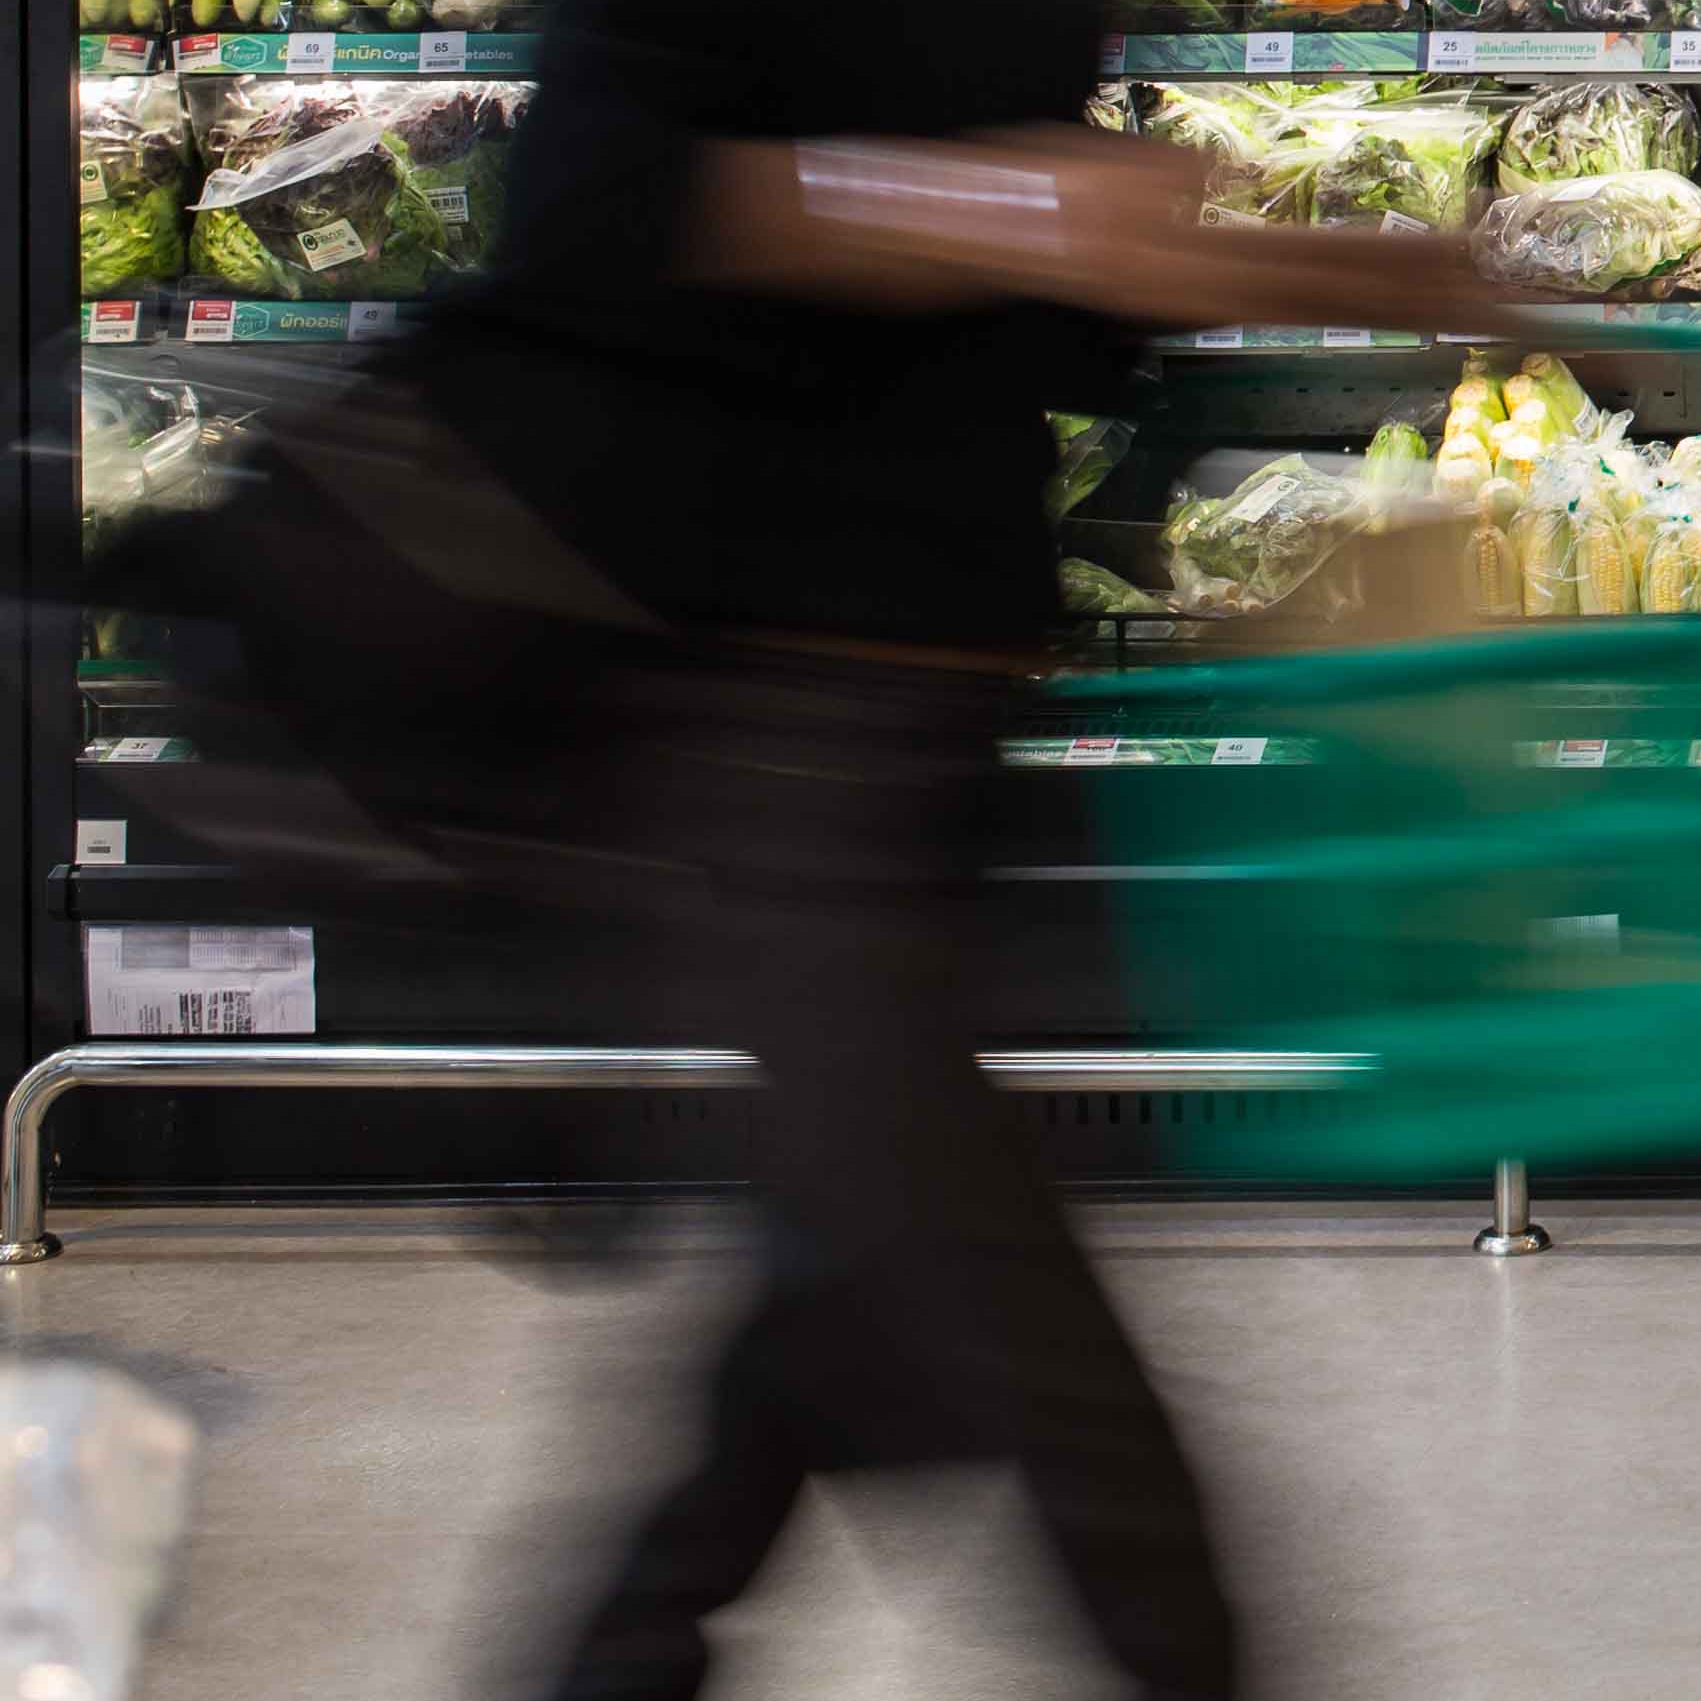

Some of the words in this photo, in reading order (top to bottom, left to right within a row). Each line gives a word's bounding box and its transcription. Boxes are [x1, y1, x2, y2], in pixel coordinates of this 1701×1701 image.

[306, 44, 319, 53] 69
[434, 43, 448, 52] 65
[1265, 42, 1279, 51] 49
[1444, 42, 1457, 51] 25
[1683, 41, 1695, 51] 35
